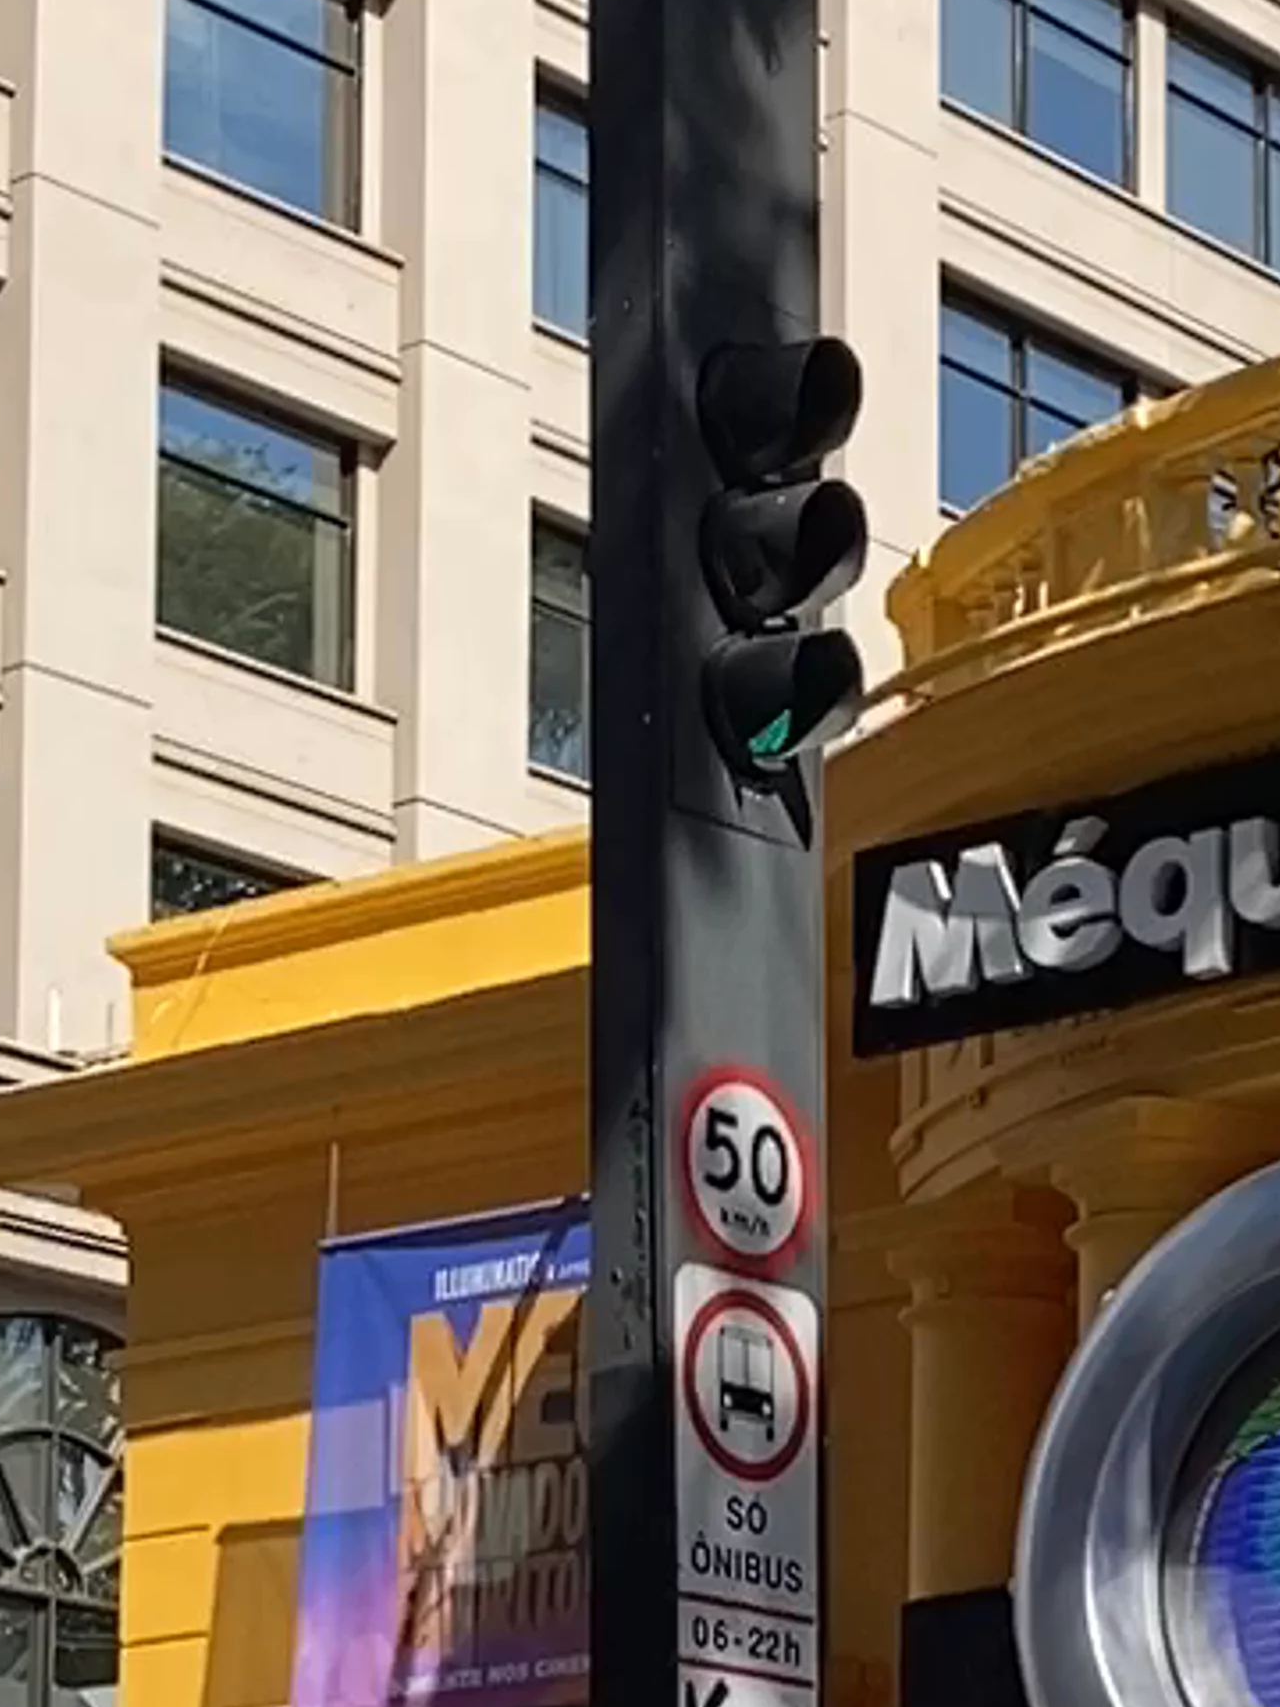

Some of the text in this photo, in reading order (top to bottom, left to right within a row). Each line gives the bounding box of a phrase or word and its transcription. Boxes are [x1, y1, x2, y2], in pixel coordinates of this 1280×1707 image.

[704, 1106, 789, 1208] 50
[720, 1206, 770, 1236] km/h
[691, 1529, 803, 1593] ÔNIBUS
[692, 1614, 801, 1667] 06-22h
